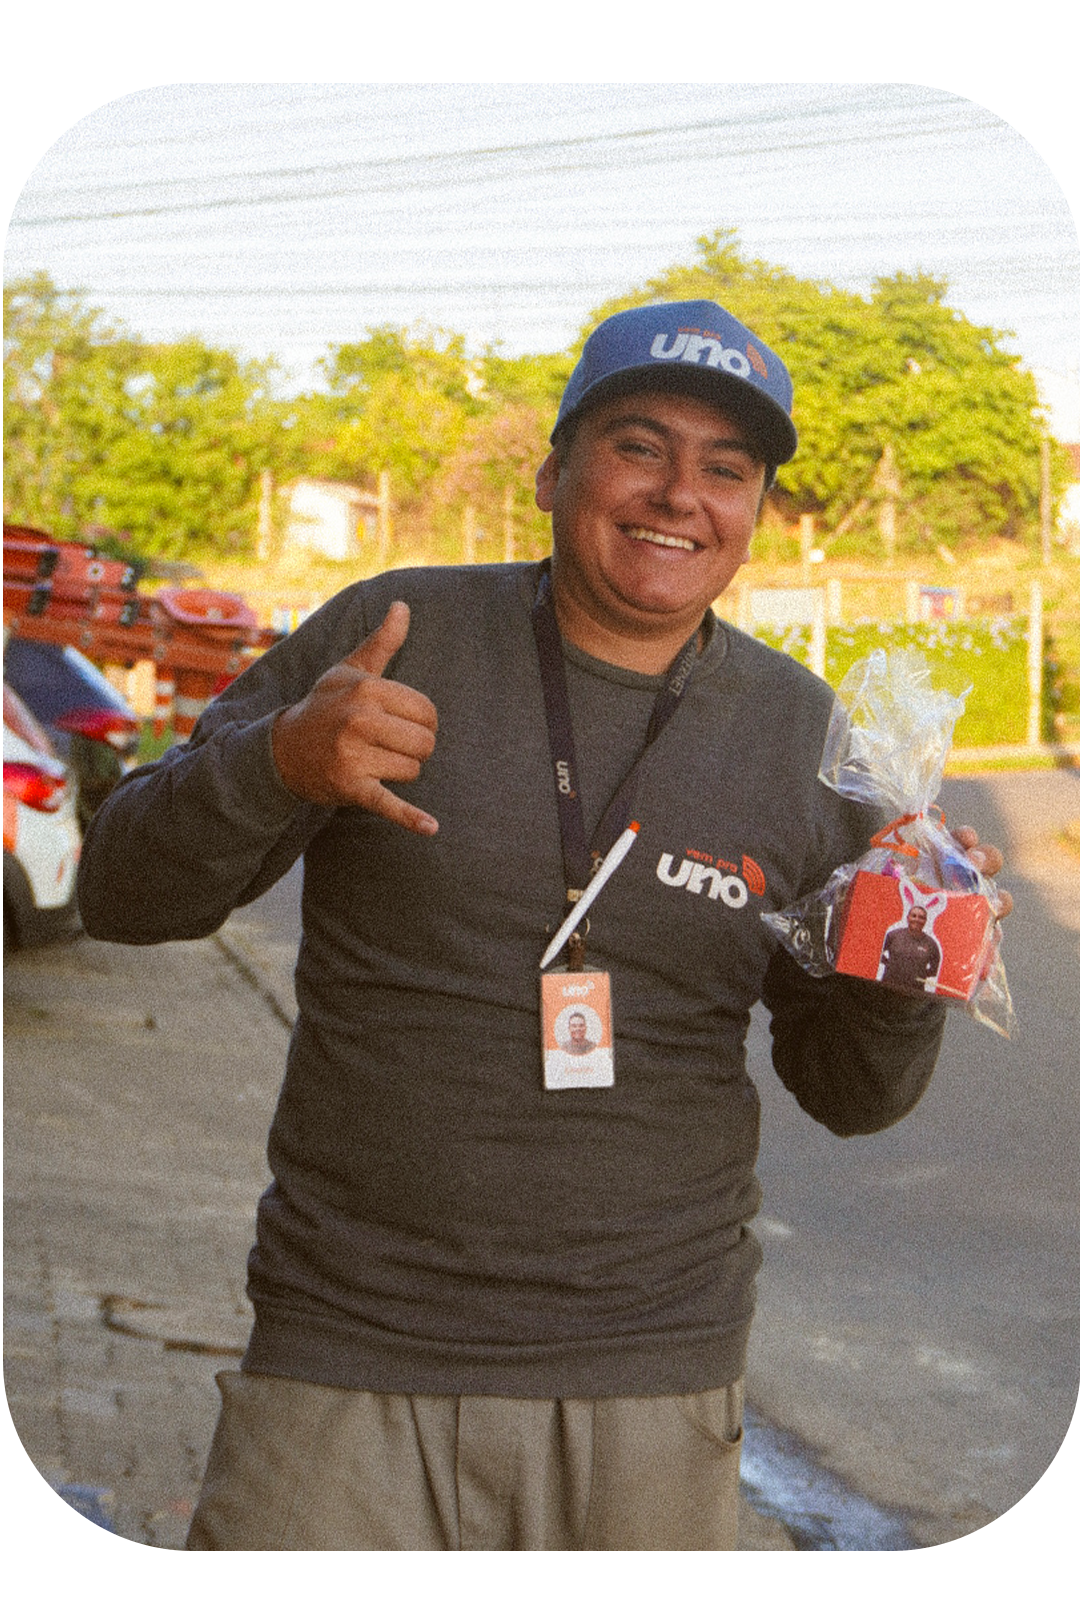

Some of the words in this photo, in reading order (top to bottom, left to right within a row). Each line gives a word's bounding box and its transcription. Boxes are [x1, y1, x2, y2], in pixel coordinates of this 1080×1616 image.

[650, 333, 751, 379] uno
[556, 760, 571, 794] uno
[686, 847, 714, 865] vem
[656, 852, 749, 909] uno
